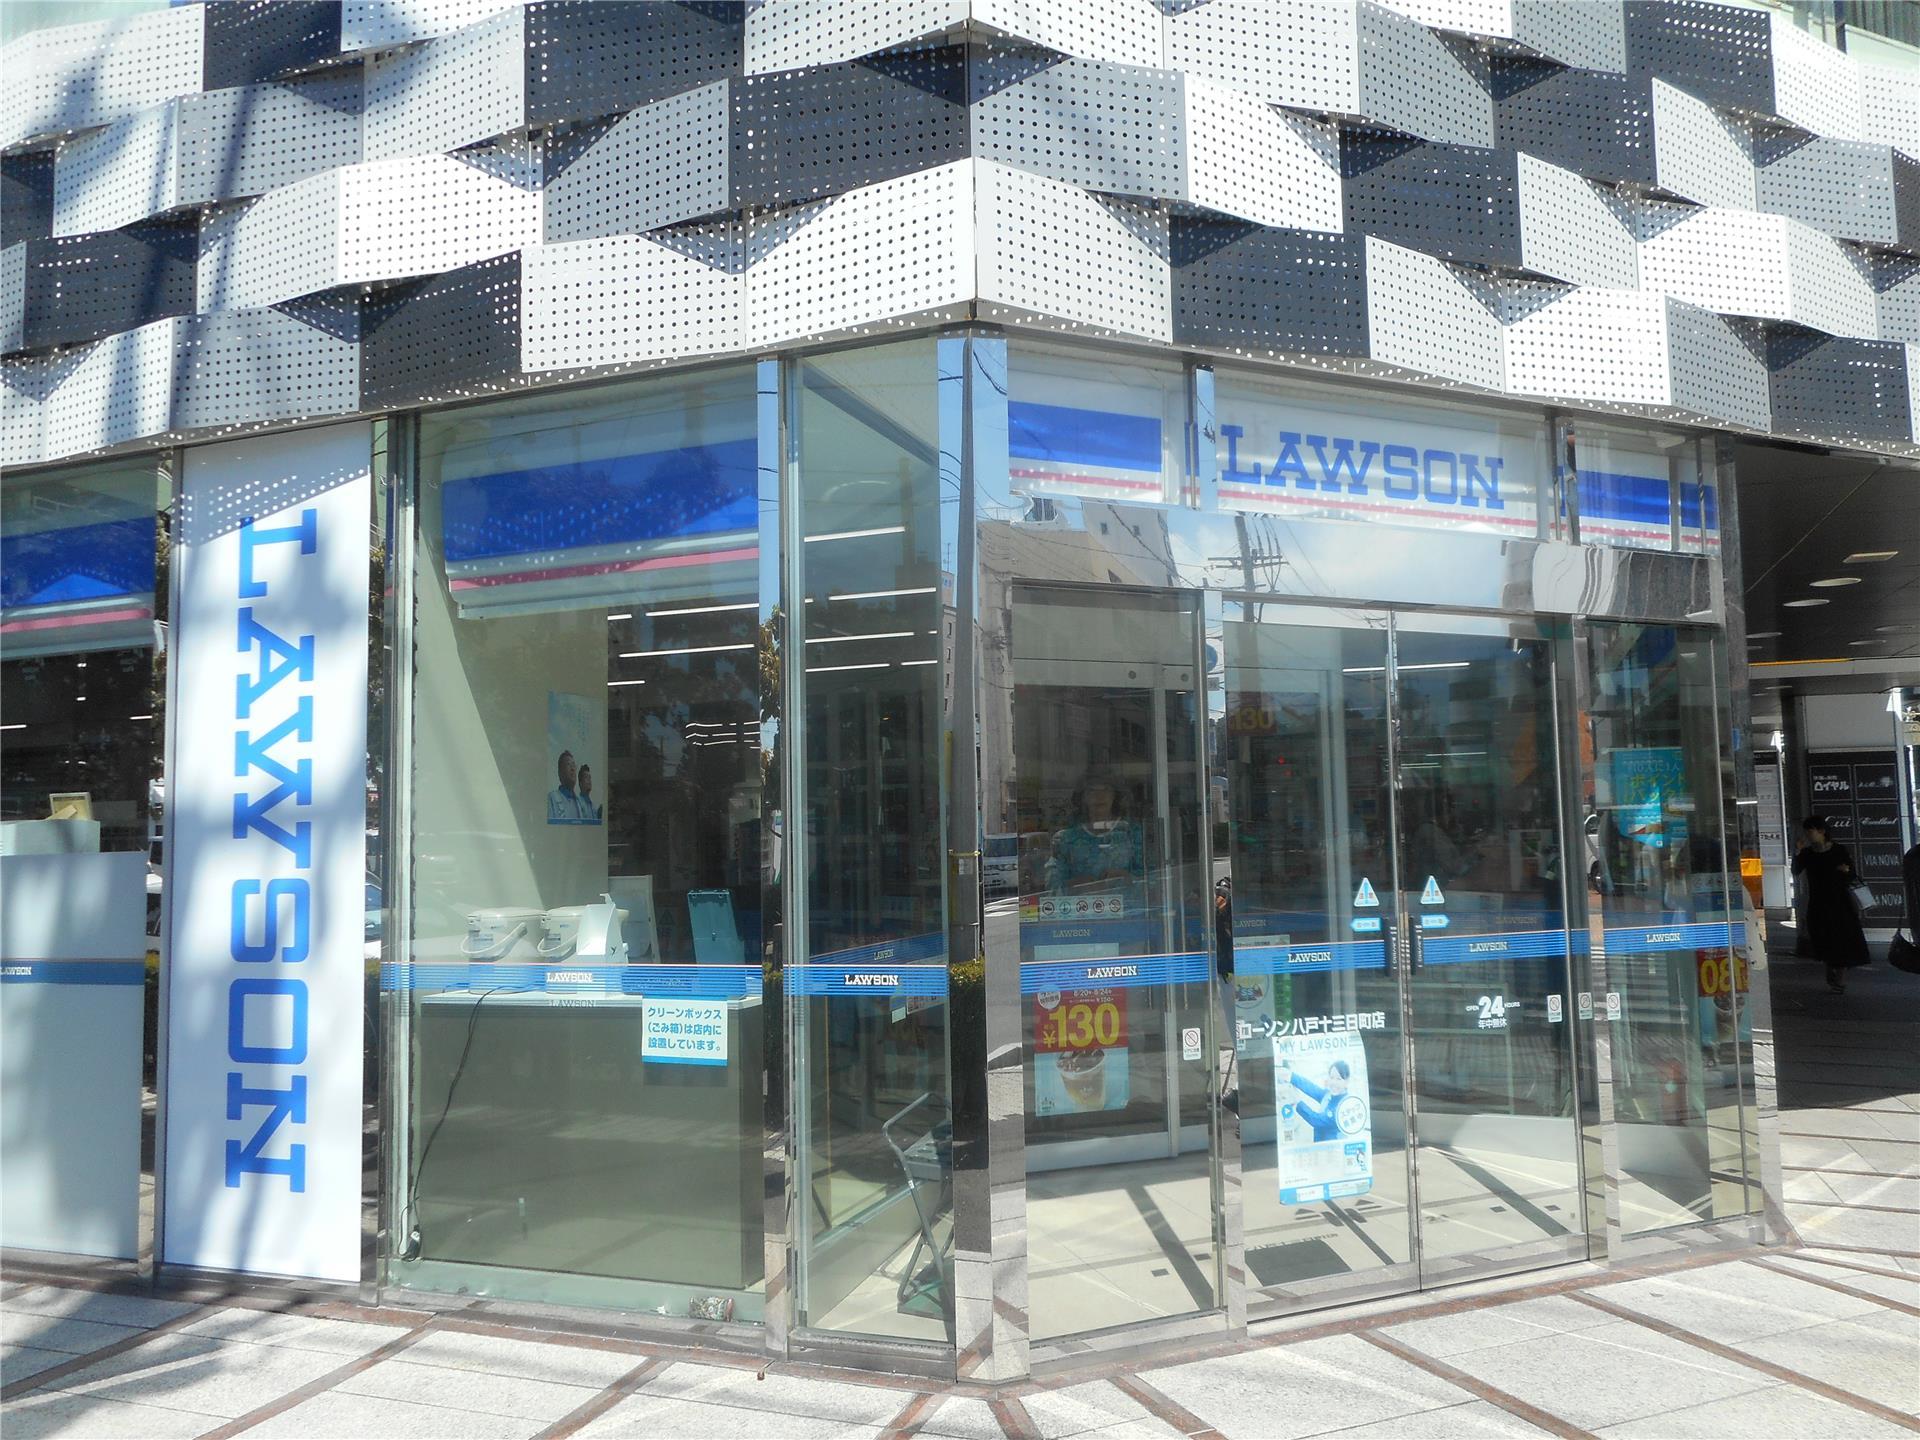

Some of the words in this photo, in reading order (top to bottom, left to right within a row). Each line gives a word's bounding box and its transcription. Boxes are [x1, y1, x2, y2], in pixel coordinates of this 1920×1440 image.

[1220, 424, 1504, 510] LAWSON
[225, 508, 317, 1193] LAWSON
[1880, 855, 1899, 866] NOVA
[1646, 933, 1680, 943] LAWSON
[1469, 942, 1508, 952] LAWSON
[1288, 952, 1331, 963] LAWSON
[546, 973, 593, 983] LAWSON
[1087, 966, 1137, 978] LAWSON
[844, 974, 899, 986] LAWSON
[1478, 995, 1505, 1019] 24
[648, 1007, 722, 1020] クリーンボックス
[648, 1022, 722, 1036] (ごみ箱)は店内に
[1478, 1019, 1507, 1029] 年中無休
[648, 1037, 721, 1051] 設置しています。
[1280, 1040, 1294, 1053] MY
[1300, 1036, 1348, 1051] LAWSON
